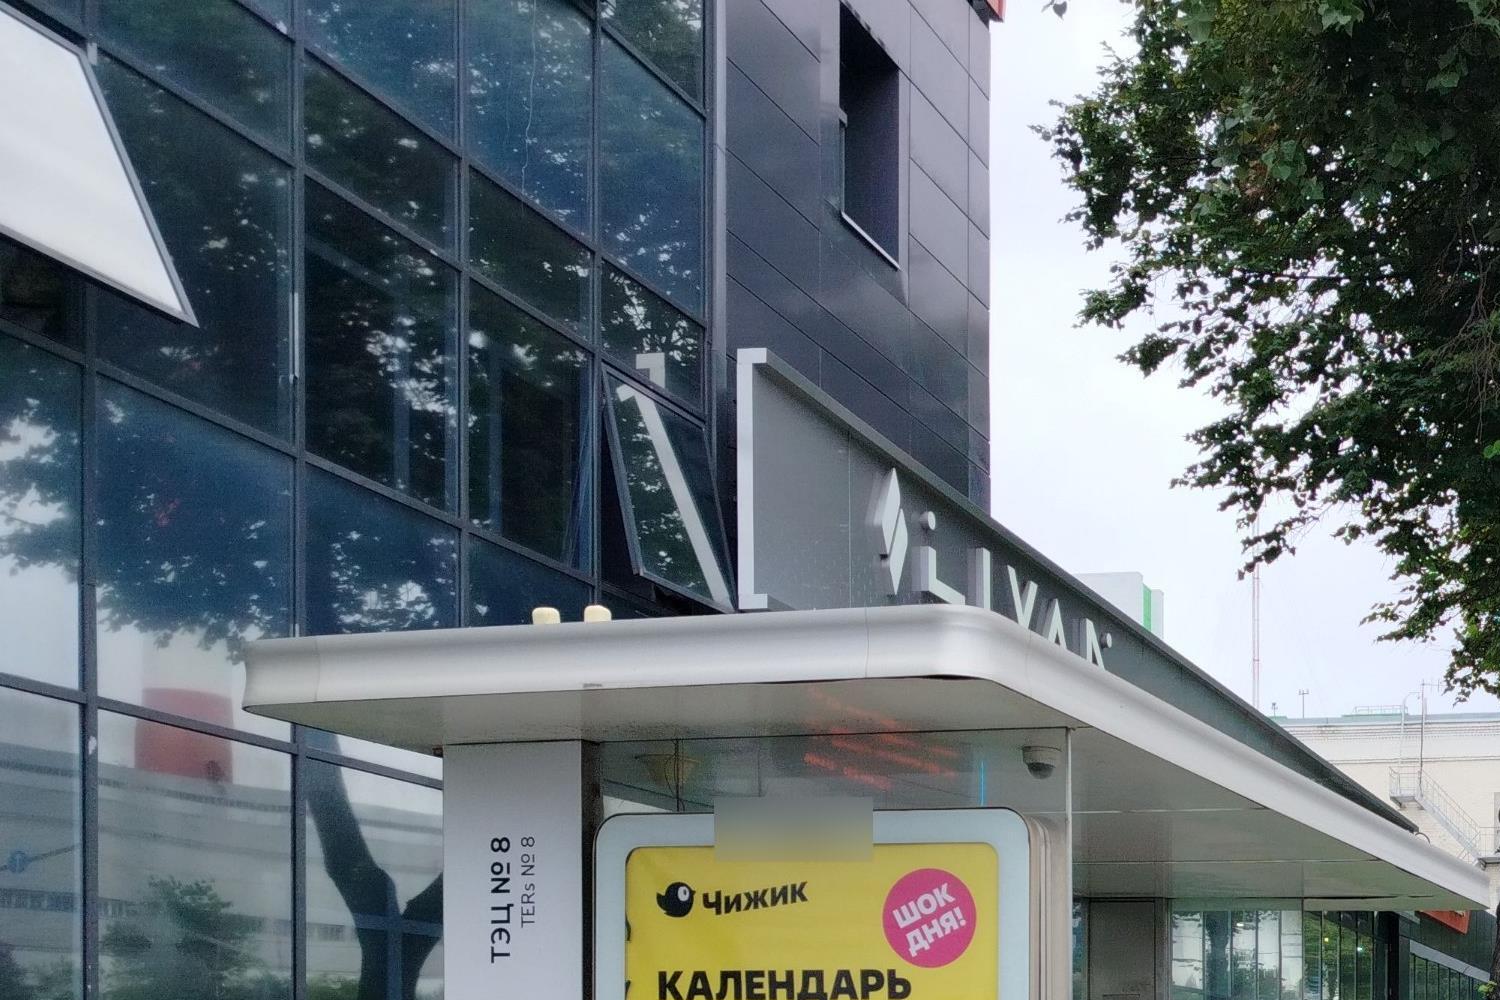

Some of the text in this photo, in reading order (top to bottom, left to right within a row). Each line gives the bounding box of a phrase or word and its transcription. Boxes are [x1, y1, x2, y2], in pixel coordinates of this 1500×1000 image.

[490, 836, 511, 853] 8
[520, 836, 536, 847] 8
[892, 883, 956, 929] ШОК
[491, 903, 514, 963] ТЭЦ
[905, 906, 967, 957] ДНЯ!
